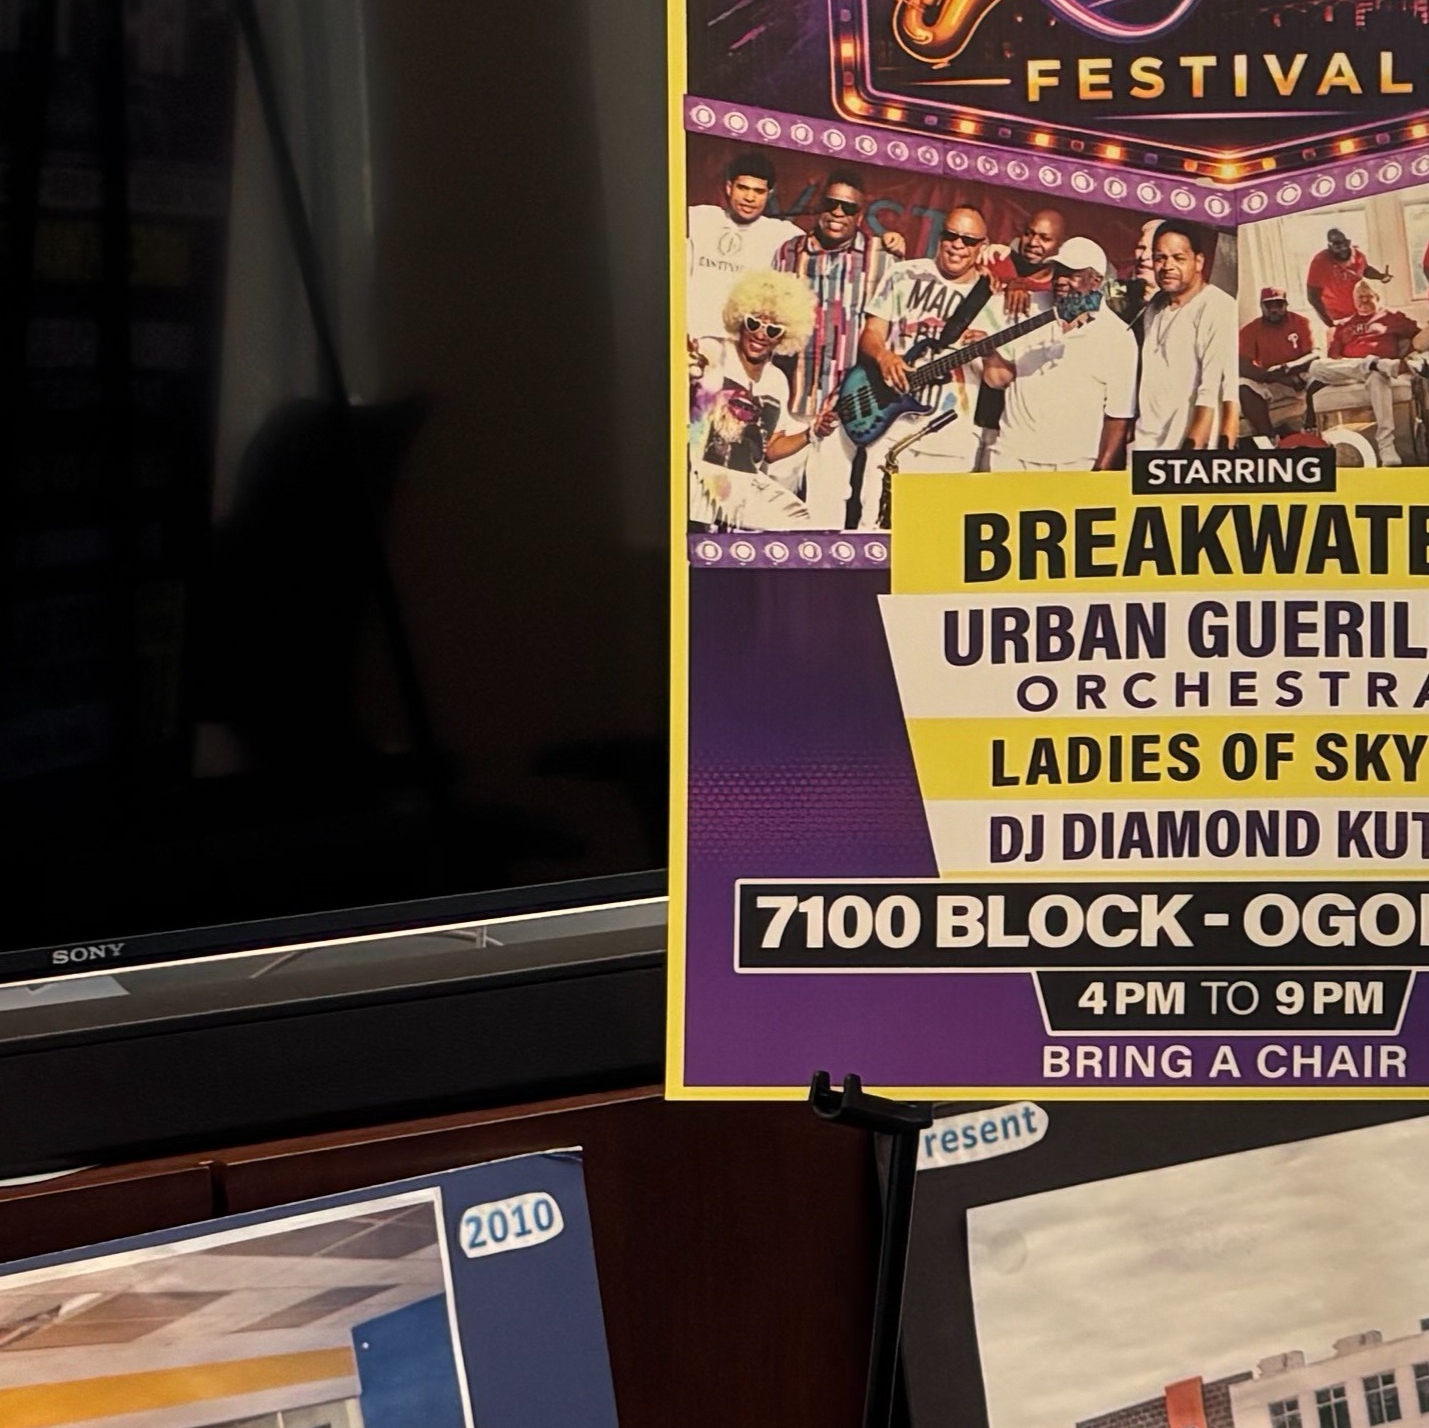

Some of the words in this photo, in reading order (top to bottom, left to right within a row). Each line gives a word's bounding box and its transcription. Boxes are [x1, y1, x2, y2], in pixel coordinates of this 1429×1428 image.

[1027, 50, 1414, 101] FESTIVAL
[1147, 457, 1322, 486] STARRING
[943, 602, 1167, 666] URBAN
[991, 736, 1203, 788] LADIES
[1222, 734, 1292, 784] OF
[990, 814, 1045, 864] DJ
[1061, 812, 1320, 862] DIAMOND
[755, 895, 920, 950] 7100
[937, 893, 1193, 948] BLOCK
[52, 943, 126, 965] SONY
[1200, 981, 1259, 1015] TO
[1042, 1045, 1193, 1079] BRING
[1209, 1046, 1240, 1078] A
[1255, 1044, 1408, 1078] CHAIR
[922, 1105, 1038, 1158] resent
[463, 1199, 555, 1250] 2010
